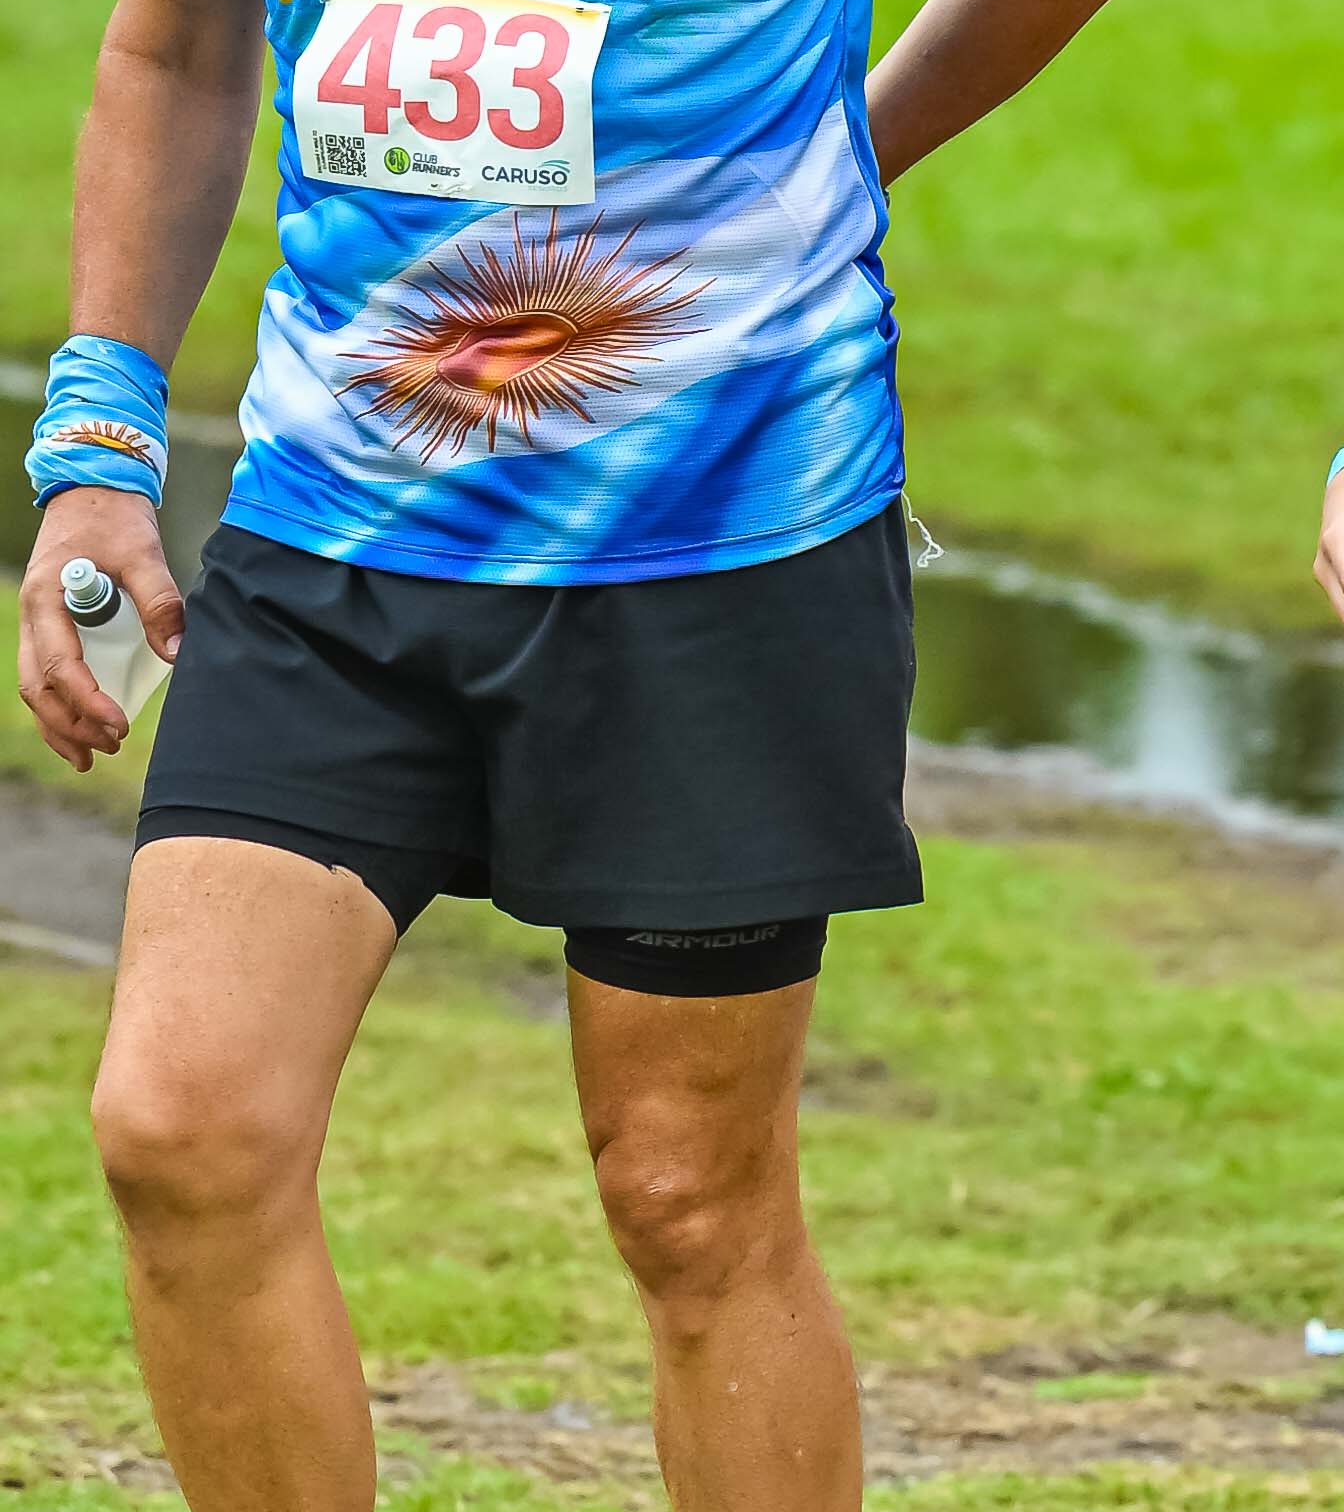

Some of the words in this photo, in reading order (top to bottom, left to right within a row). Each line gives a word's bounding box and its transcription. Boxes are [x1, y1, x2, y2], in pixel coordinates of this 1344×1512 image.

[317, 3, 570, 150] 433
[412, 152, 438, 164] CLUB
[481, 165, 568, 186] CARUSO
[625, 925, 781, 950] ARMOUR
